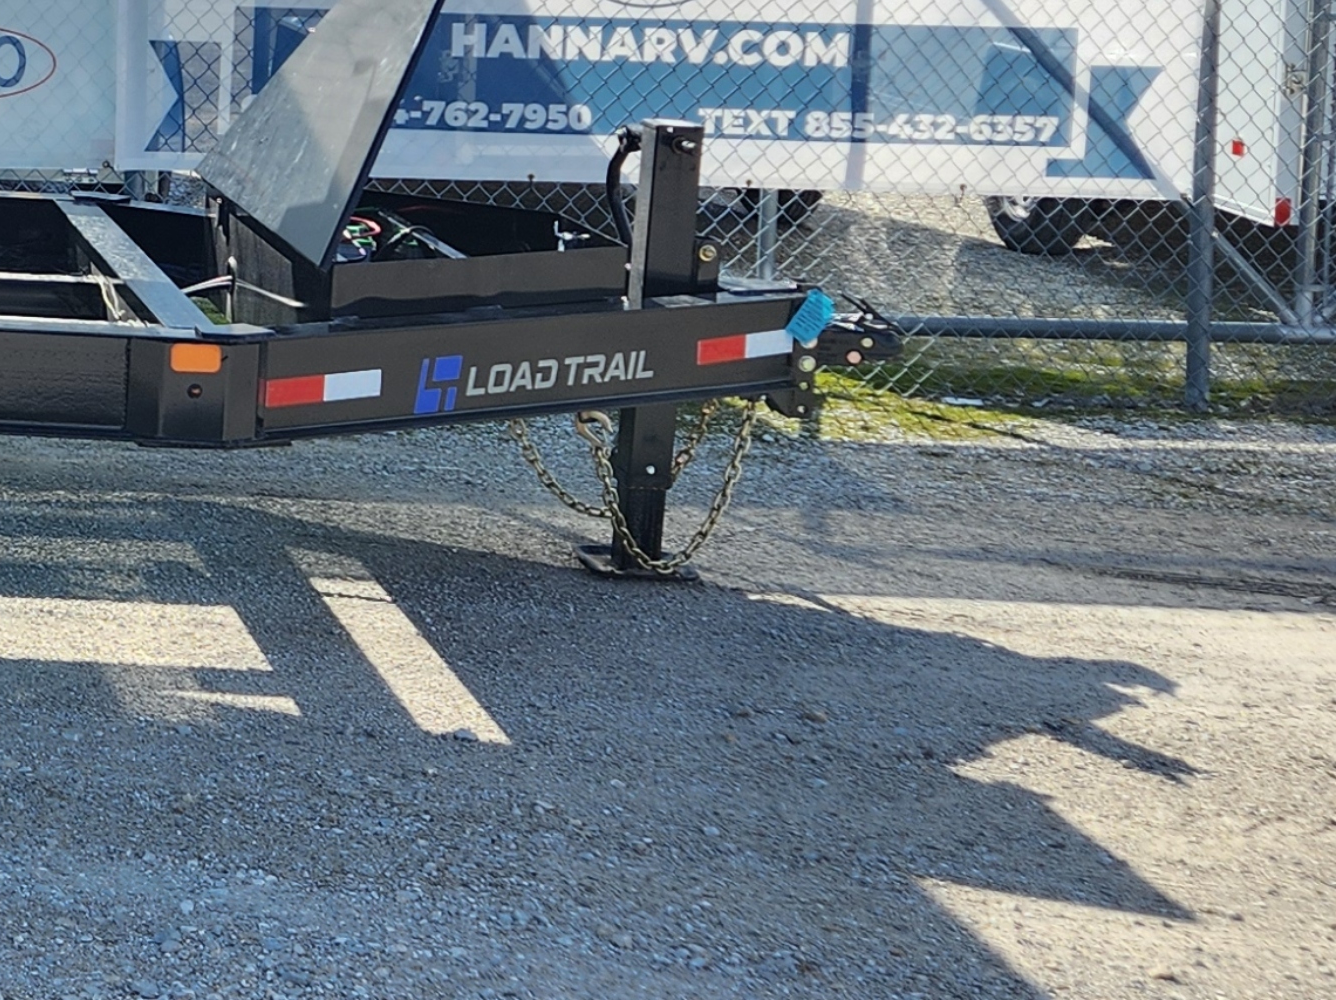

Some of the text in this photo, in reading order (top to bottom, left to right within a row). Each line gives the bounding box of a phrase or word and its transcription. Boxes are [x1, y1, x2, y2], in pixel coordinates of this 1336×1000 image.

[450, 22, 851, 67] HANNARV.COM
[392, 99, 592, 132] 4-762-7950
[697, 107, 1060, 144] TEXT 855-432-6357
[465, 350, 654, 397] LOAD TRAIL
